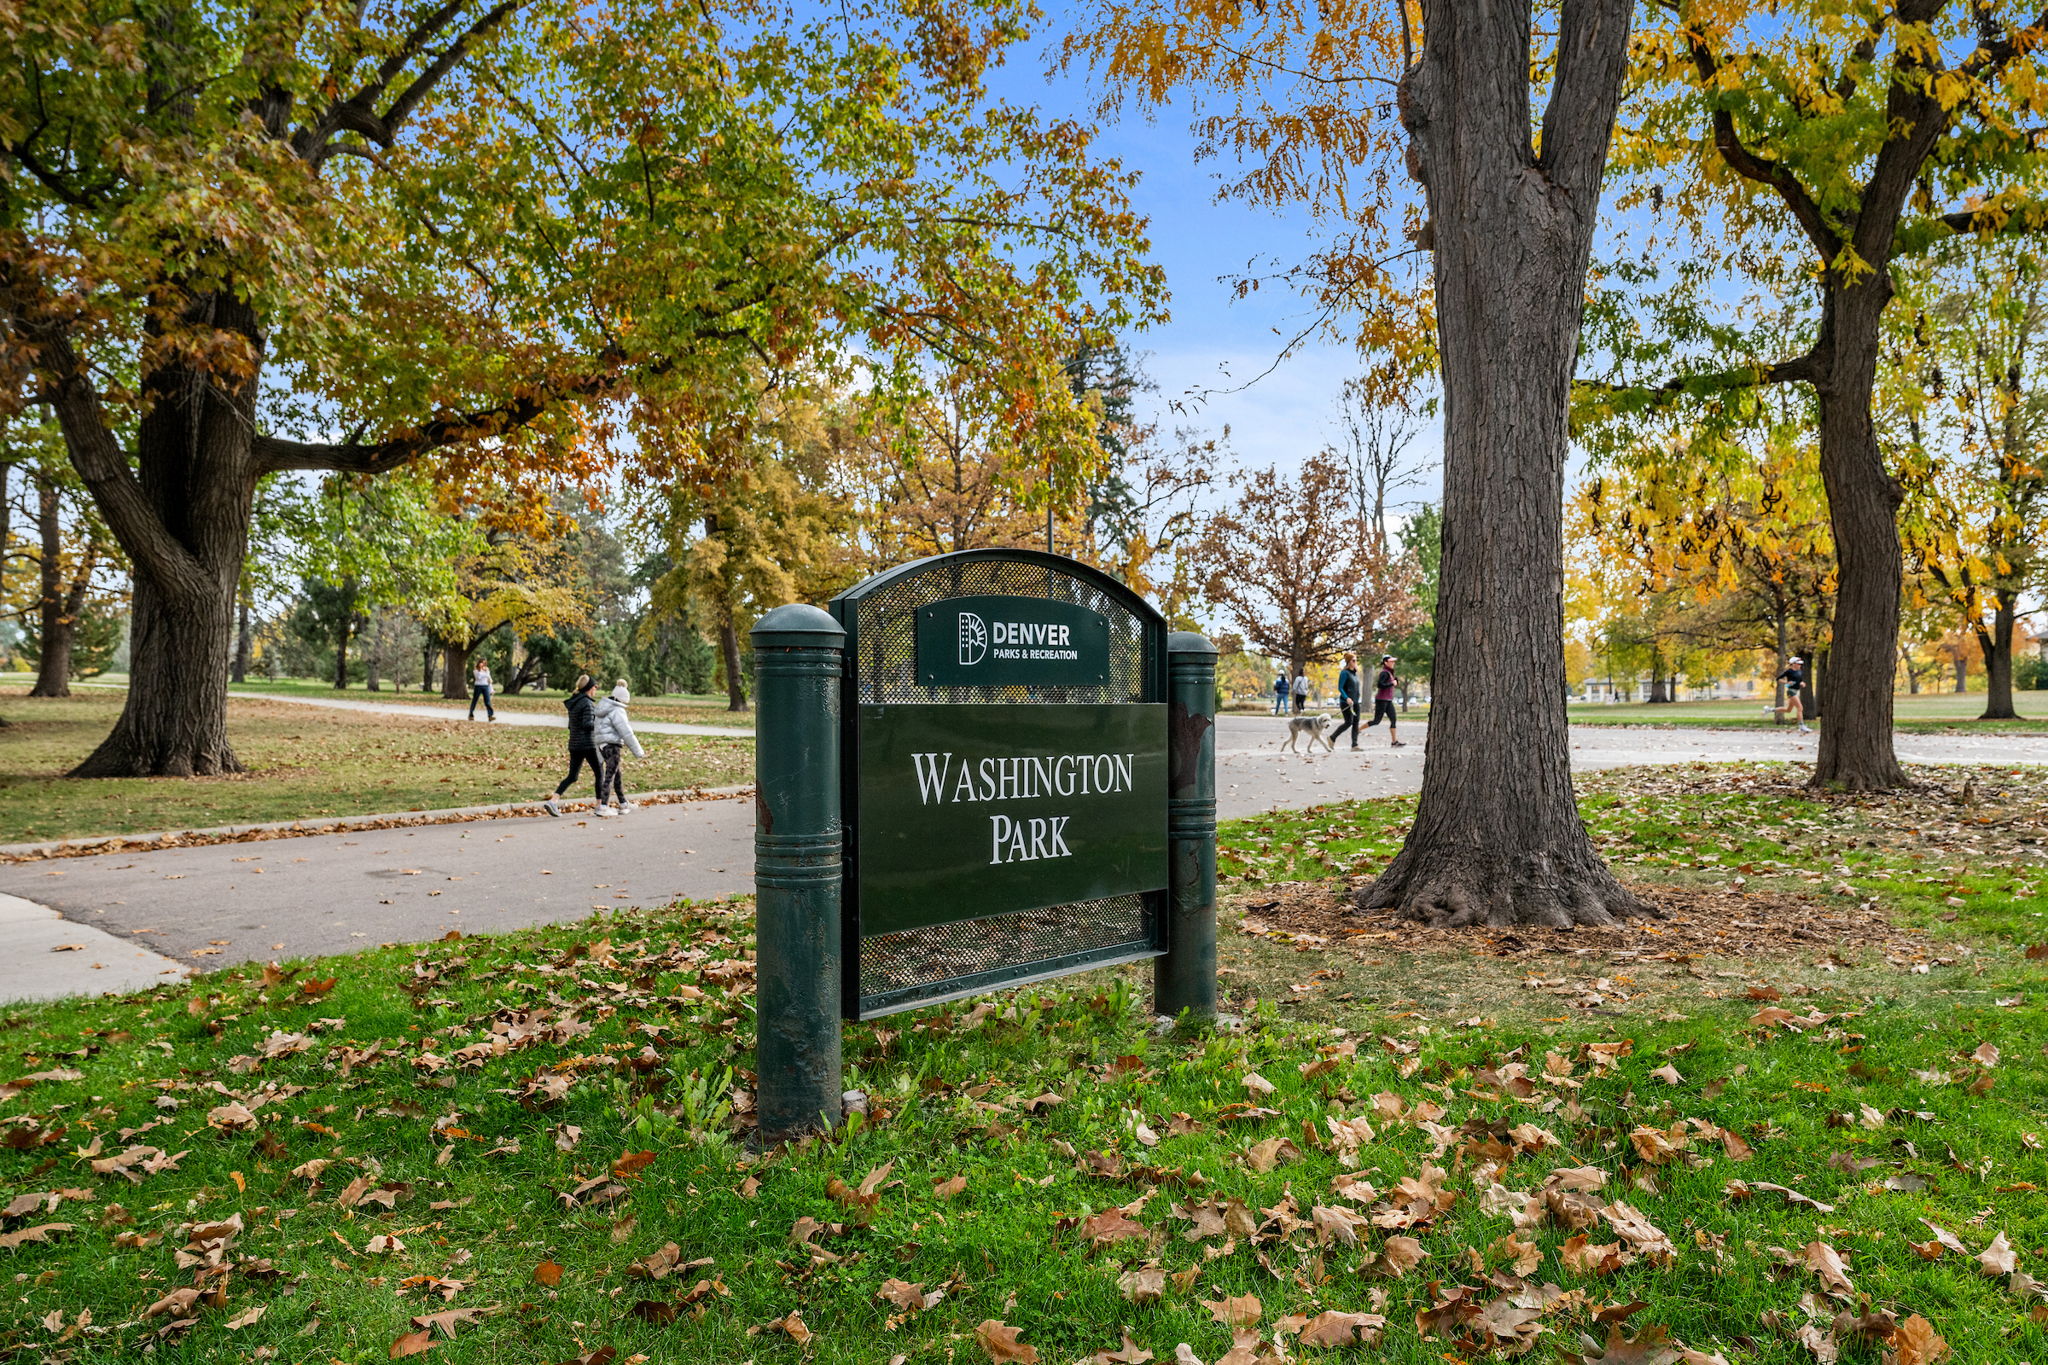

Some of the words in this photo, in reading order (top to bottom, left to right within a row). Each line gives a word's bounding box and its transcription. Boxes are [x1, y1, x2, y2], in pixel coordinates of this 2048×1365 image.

[993, 621, 1070, 646] DENVER
[993, 648, 1020, 660] PARKS
[1021, 649, 1029, 660] &
[1029, 649, 1078, 661] RECREATION
[911, 752, 1134, 806] WASHINGTON
[989, 814, 1073, 865] PARK
